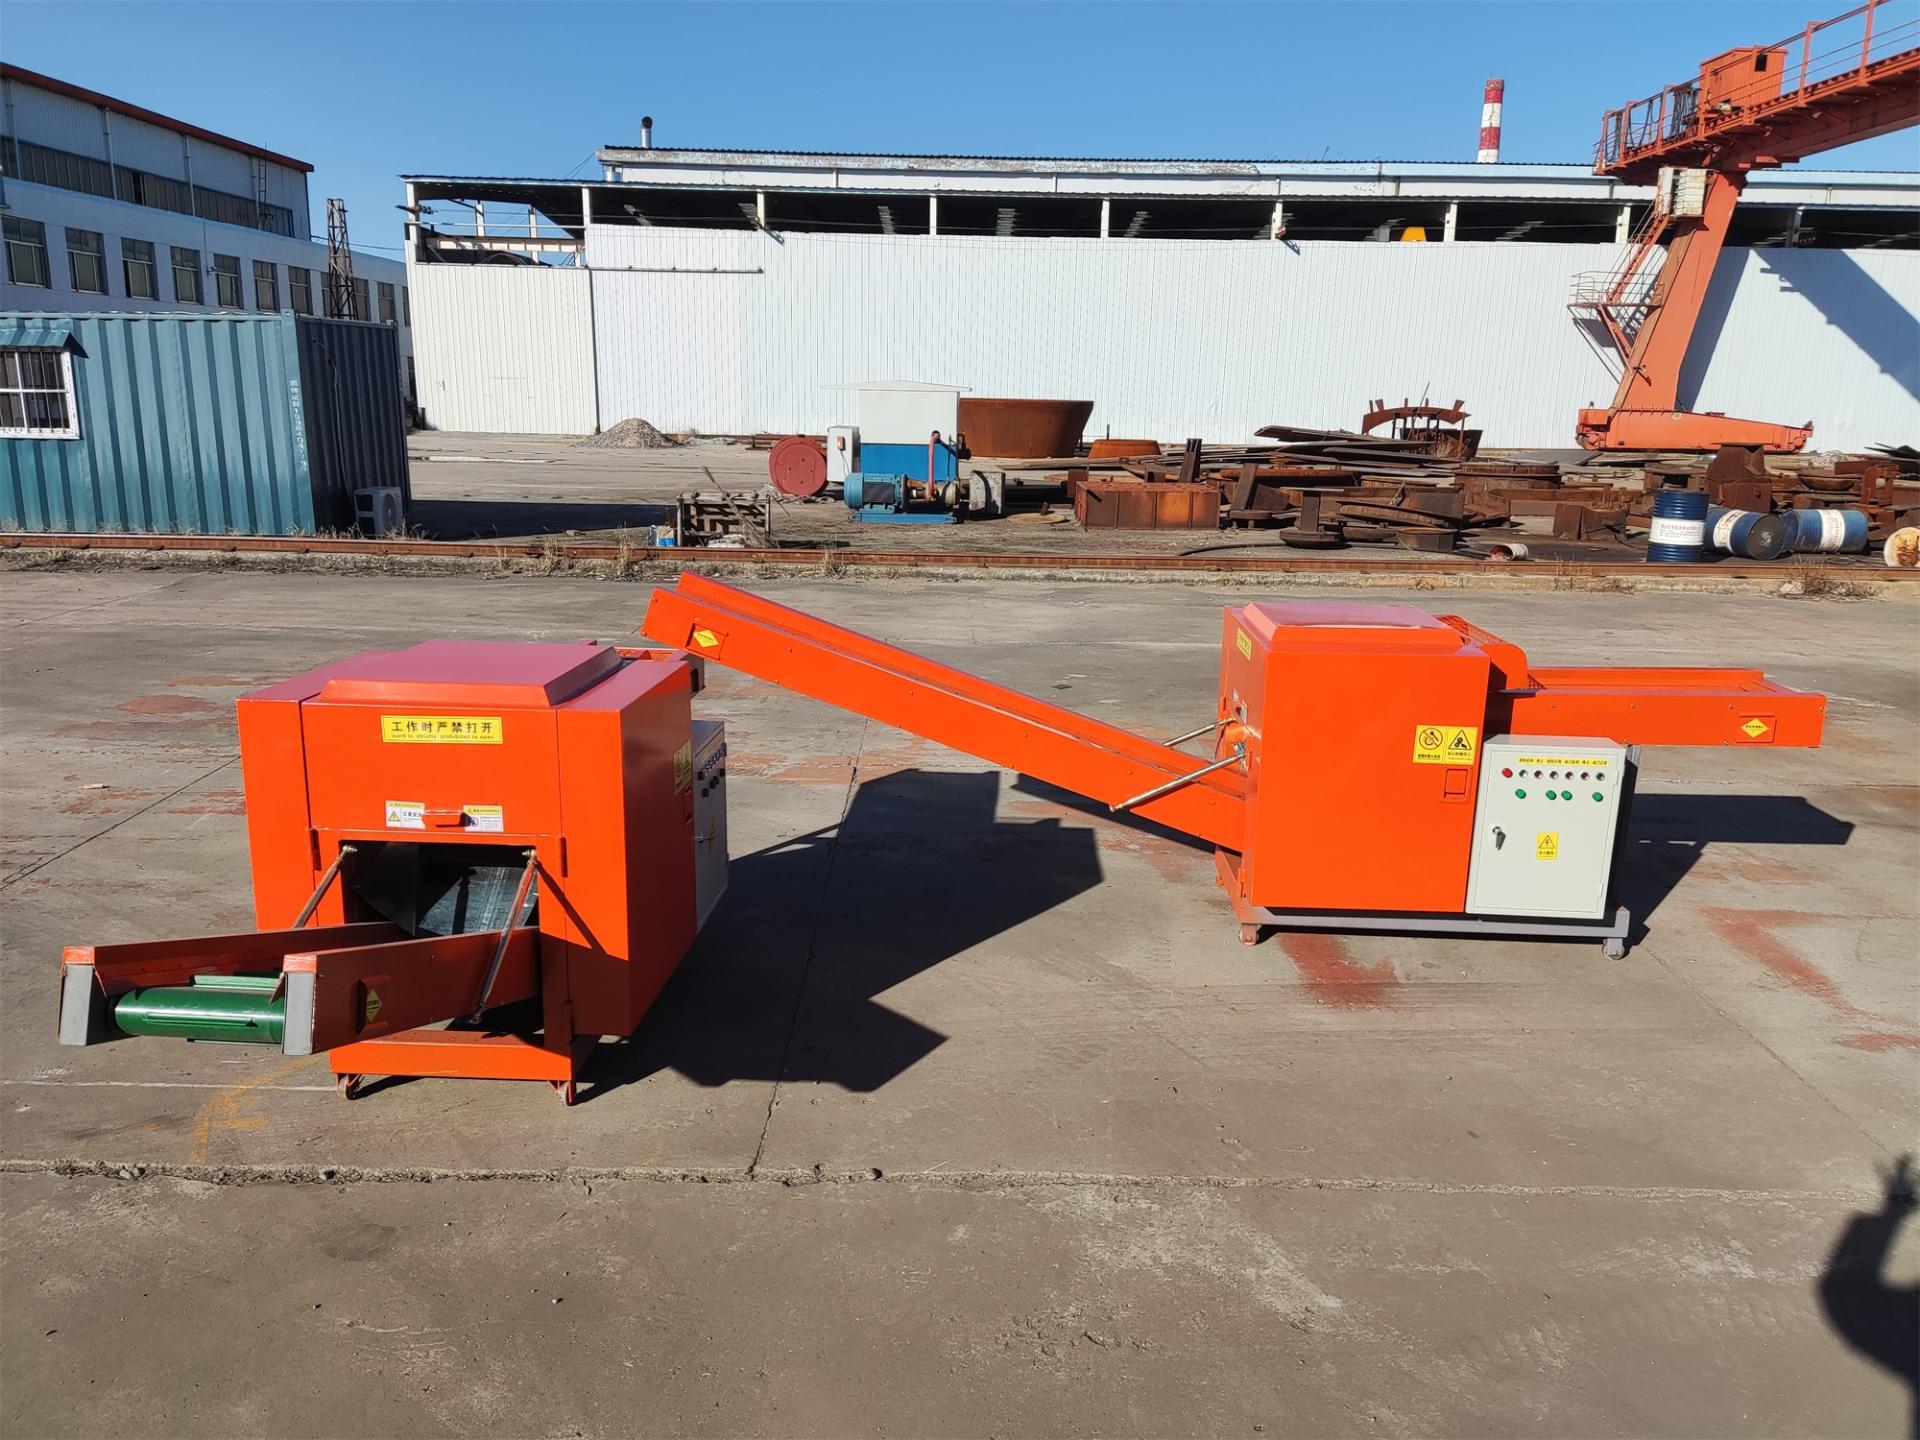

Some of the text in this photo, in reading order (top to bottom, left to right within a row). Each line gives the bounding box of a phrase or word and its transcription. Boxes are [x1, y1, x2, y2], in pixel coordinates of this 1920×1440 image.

[392, 721, 493, 734] 工作时严禁打开
